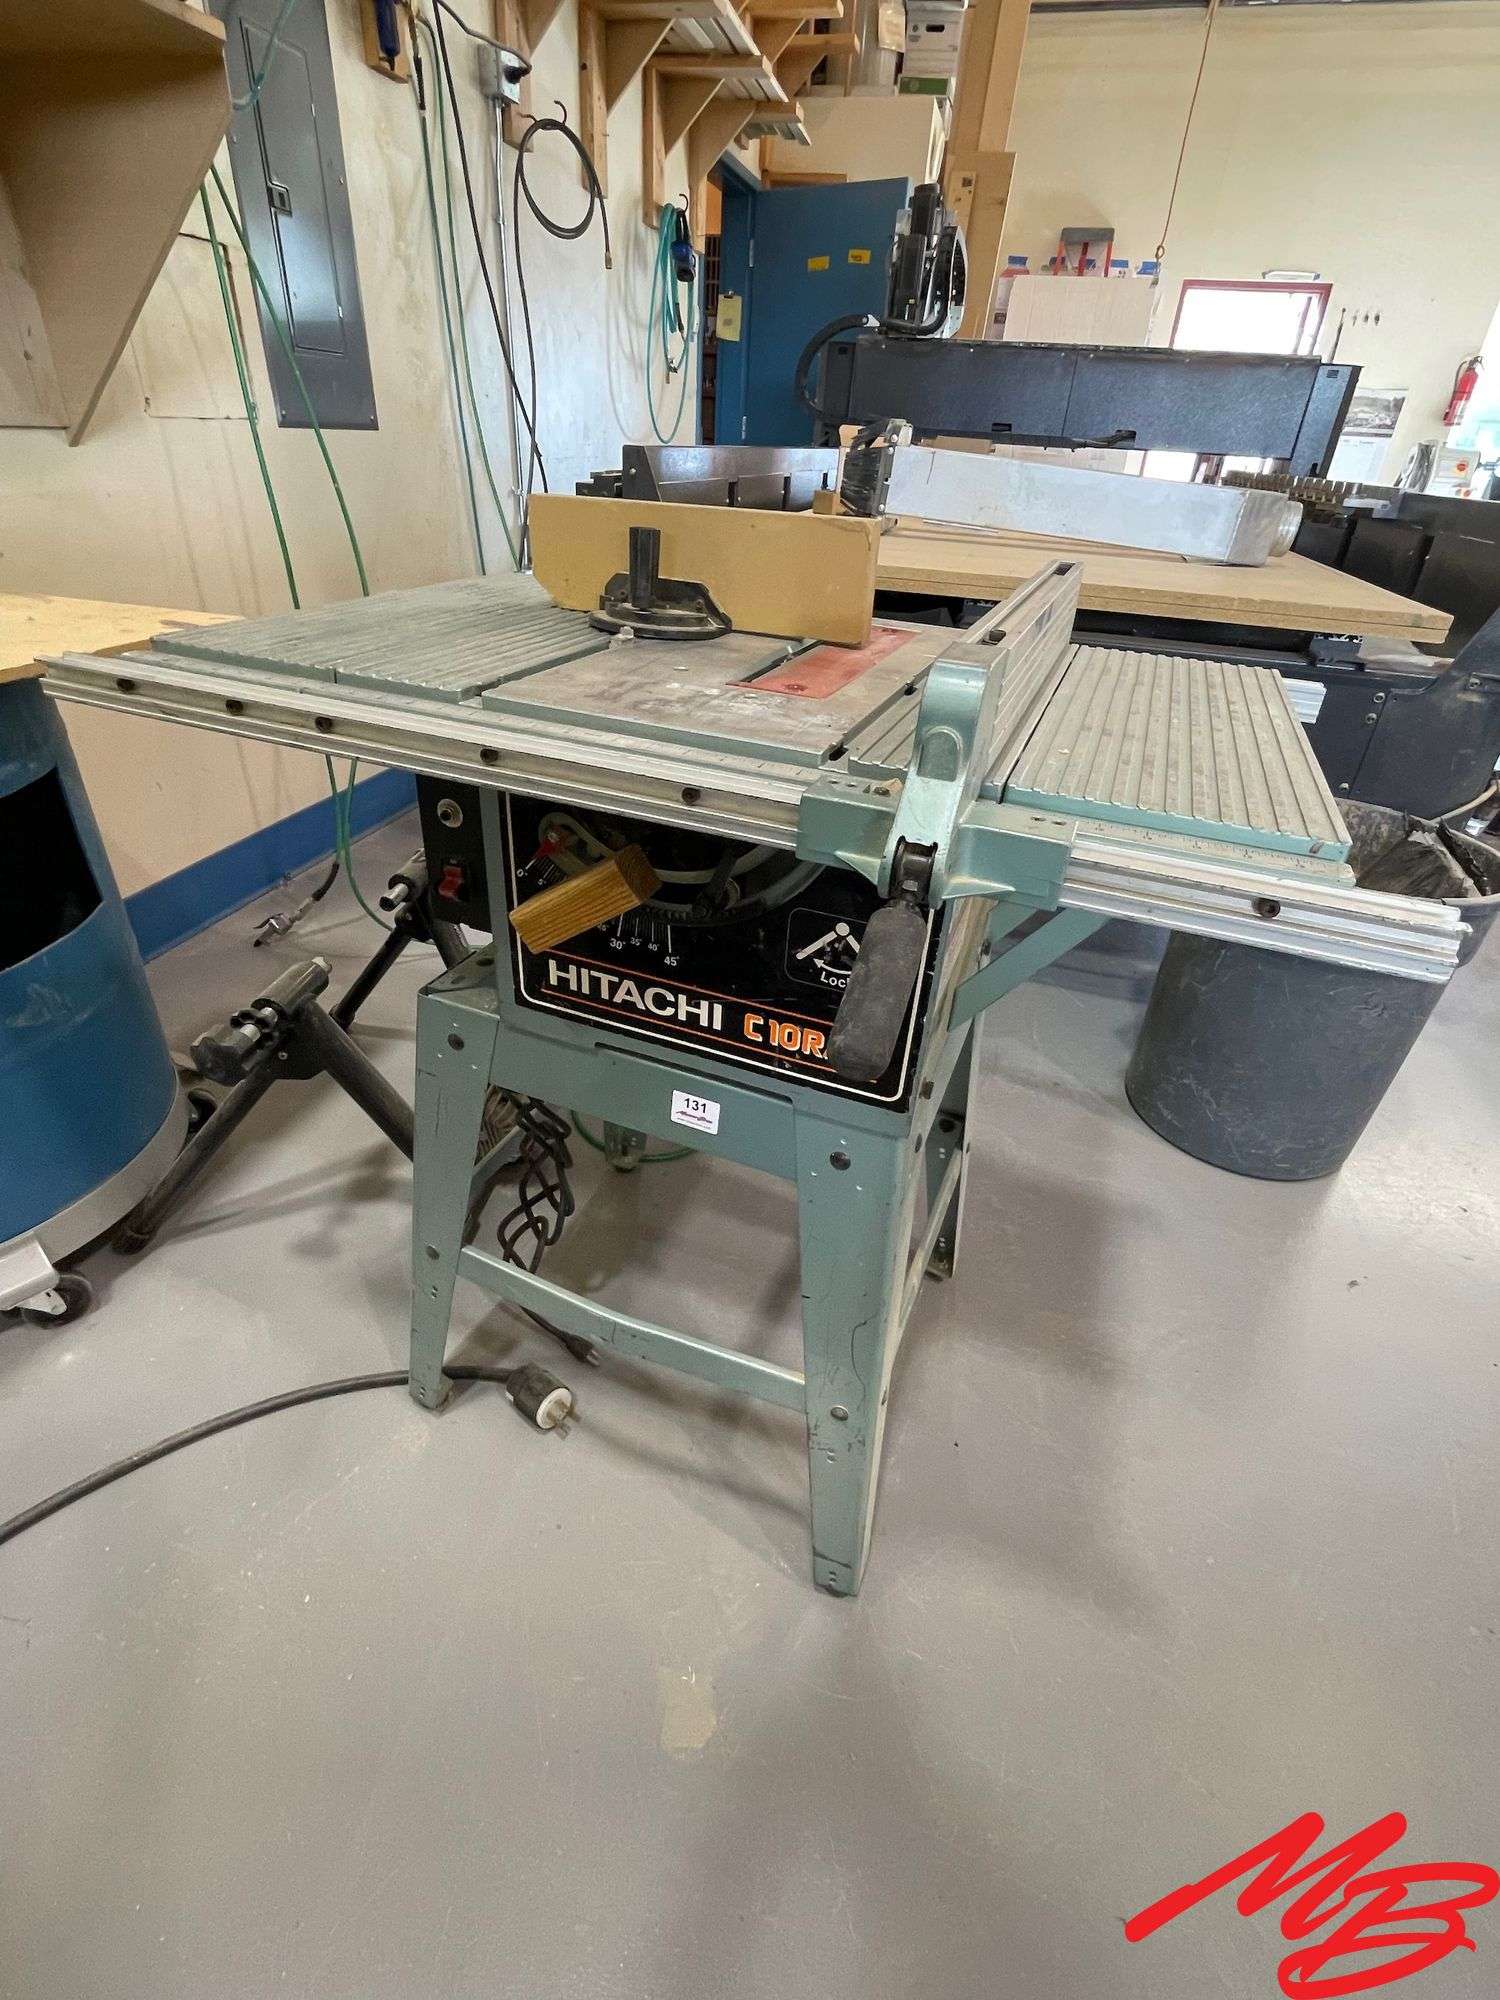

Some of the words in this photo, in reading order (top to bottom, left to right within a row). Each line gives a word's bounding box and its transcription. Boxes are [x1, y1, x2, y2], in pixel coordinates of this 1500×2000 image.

[548, 958, 723, 1031] HITACHI
[743, 1012, 829, 1060] C10R
[684, 1097, 707, 1114] 131
